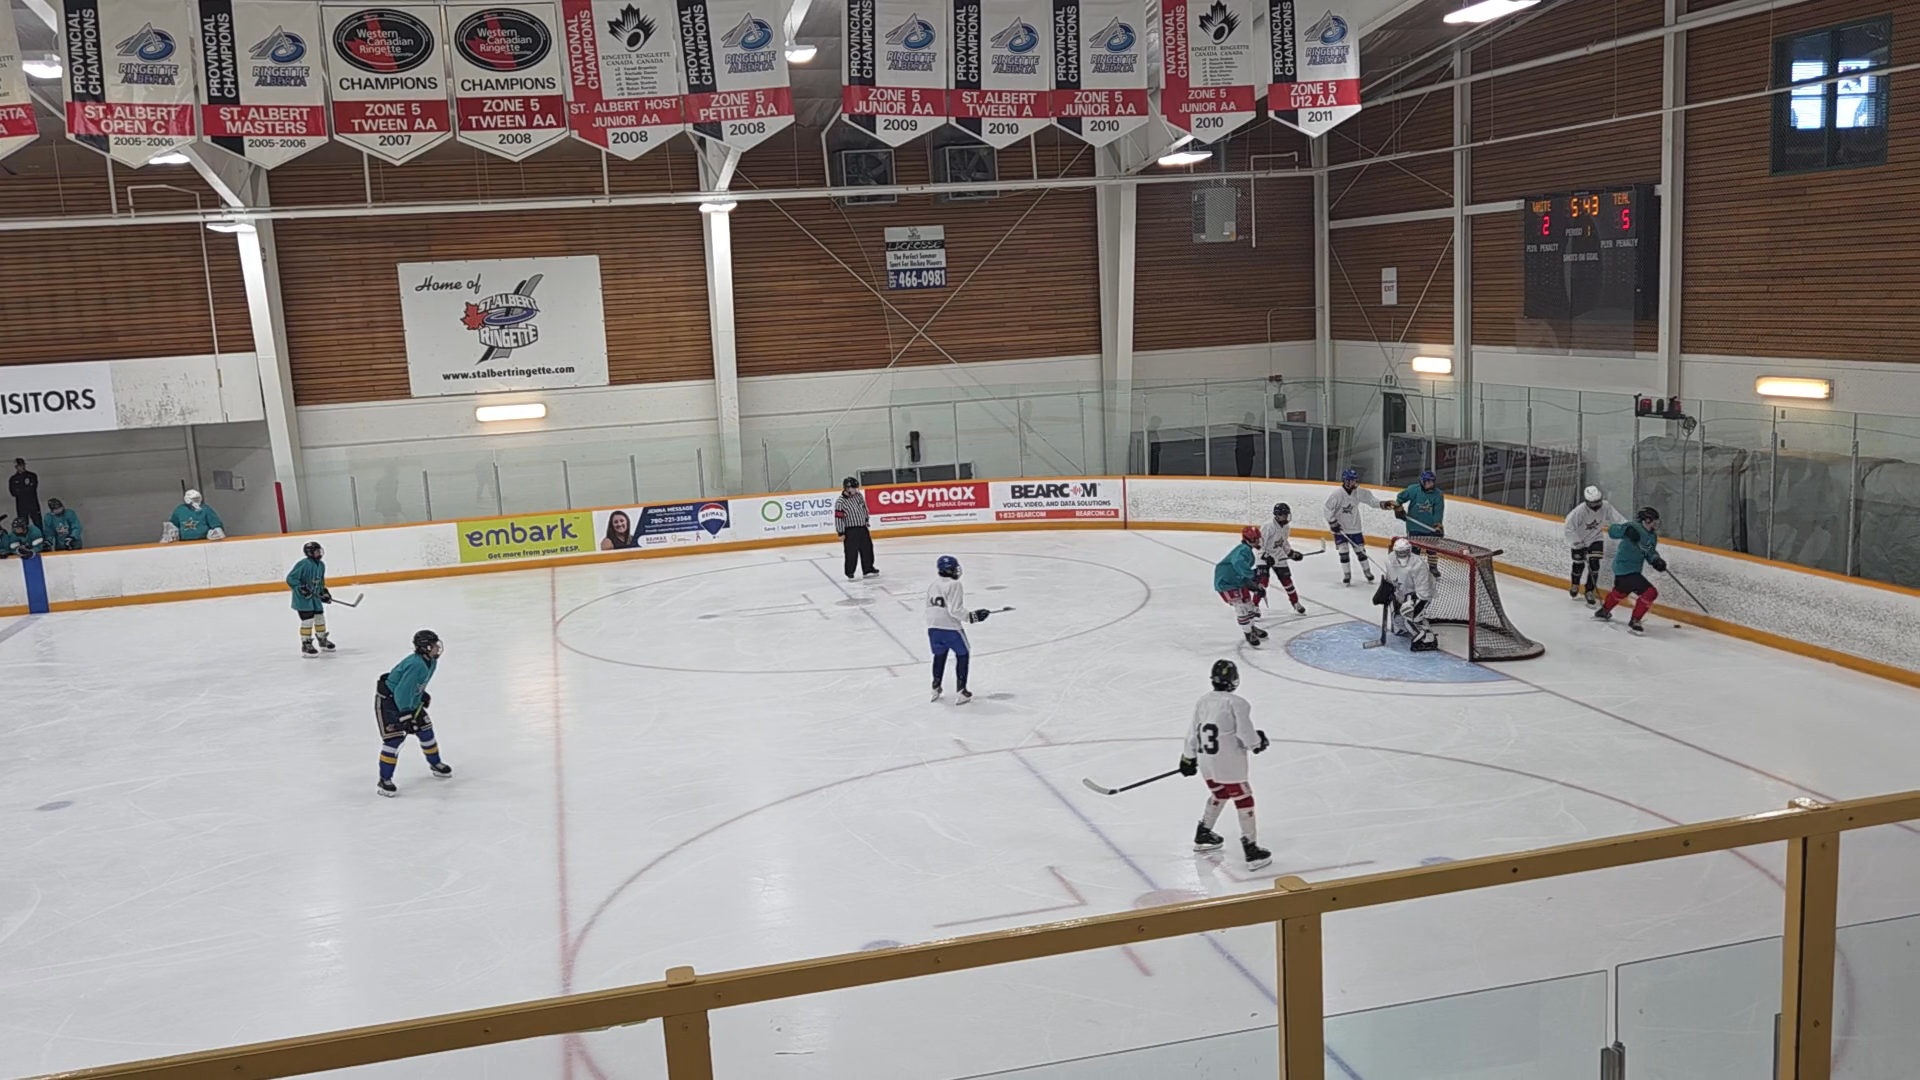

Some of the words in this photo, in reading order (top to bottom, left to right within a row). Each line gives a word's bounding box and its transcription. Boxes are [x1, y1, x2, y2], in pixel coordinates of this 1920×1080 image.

[356, 28, 398, 39] Western
[476, 27, 518, 37] Western
[850, 0, 861, 77] PROVINCIAL
[1271, 0, 1284, 75] PROVINCIAL
[1282, 0, 1295, 76] CHAMPIONS
[366, 37, 414, 46] Canadian
[486, 35, 533, 45] Canadian
[681, 6, 700, 85] PROVINCIAL
[693, 4, 713, 86] CHAMPIONS
[862, 0, 873, 79] CHAMPIONS
[956, 5, 967, 81] PROVINCIAL
[968, 4, 979, 82] CHAMPIONS
[1056, 5, 1068, 81] PROVINCIAL
[1068, 5, 1078, 82] CHAMPIONS
[1165, 9, 1176, 75] NATIONAL
[1176, 5, 1188, 79] CHAMPIONS
[67, 10, 86, 94] PROVINCIAL
[81, 8, 101, 95] CHAMPIONS
[218, 13, 236, 98] CHAMPIONS
[359, 44, 402, 56] Ringette
[479, 43, 521, 54] Ringette
[567, 16, 585, 86] NATIONAL
[580, 10, 599, 90] CHAMPIONS
[1305, 45, 1350, 58] RINGETTE
[202, 15, 222, 97] PROVINCIAL
[725, 51, 776, 64] RINGETTE
[886, 52, 937, 63] RINGETTE
[991, 54, 1040, 65] RINGETTE
[1090, 54, 1138, 65] RINGETTE
[1307, 55, 1348, 67] ALBERTA
[119, 63, 178, 76] RINGETTE
[252, 65, 310, 78] RINGETTE
[728, 61, 774, 74] ALBERTA
[888, 61, 933, 72] ALBERTA
[993, 63, 1037, 74] ALBERTA
[1092, 63, 1135, 74] ALBERTA
[121, 74, 175, 86] ALBERTA
[254, 76, 308, 88] ALBERTA
[339, 76, 438, 91] CHAMPIONS
[460, 77, 556, 92] CHAMPIONS
[868, 88, 906, 101] ZONE
[911, 90, 921, 102] 5
[1188, 89, 1217, 100] ZONE
[1219, 88, 1227, 99] 5
[1290, 83, 1325, 96] ZONE
[1328, 81, 1337, 93] 5
[710, 94, 749, 107] ZONE
[755, 91, 764, 103] 5
[962, 91, 983, 104] ST.
[984, 92, 1037, 105] ALBERT
[1074, 91, 1112, 103] ZONE
[1114, 91, 1123, 103] 5
[1290, 95, 1314, 108] U12
[1317, 94, 1337, 107] AA
[84, 104, 110, 119] ST.
[114, 103, 178, 120] ALBERT
[365, 103, 405, 116] ZONE
[411, 103, 421, 114] 5
[482, 99, 525, 112] ZONE
[529, 98, 540, 111] 5
[571, 103, 589, 114] ST.
[594, 101, 641, 113] ALBERT
[645, 98, 677, 110] HOST
[700, 107, 748, 121] PETITE
[754, 103, 778, 116] AA
[854, 101, 907, 114] JUNIOR
[911, 102, 934, 115] AA
[966, 104, 1017, 117] TWEEN
[1022, 105, 1033, 117] A
[1061, 103, 1112, 116] JUNIOR
[1114, 103, 1137, 115] AA
[1178, 101, 1217, 113] JUNIOR
[1220, 101, 1236, 112] AA
[219, 107, 246, 121] ST.
[248, 107, 311, 121] ALBERT
[468, 115, 527, 128] TWEEN
[532, 114, 557, 127] AA
[592, 115, 637, 128] JUNIOR
[641, 113, 661, 125] AA
[1307, 110, 1333, 123] 2011
[100, 120, 147, 134] OPEN
[152, 120, 166, 134] C
[225, 120, 307, 134] MASTERS
[351, 118, 408, 131] TWEEN
[413, 118, 437, 131] AA
[729, 122, 766, 136] 2008
[883, 119, 918, 131] 2009
[988, 122, 1019, 135] 2010
[1090, 119, 1120, 132] 2010
[1195, 116, 1224, 129] 2010
[113, 136, 175, 148] 2005-2006
[247, 138, 307, 149] 2005-2006
[378, 134, 412, 146] 2007
[498, 133, 532, 145] 2008
[611, 131, 649, 145] 2008
[1571, 195, 1599, 217] 5:43
[1543, 215, 1550, 235] 2
[1621, 209, 1630, 229] 5
[415, 275, 463, 293] Home
[466, 272, 483, 294] of
[898, 270, 946, 288] 466-0981
[479, 325, 539, 349] RINGETTE
[442, 365, 576, 381] www.stalbertringette.com
[878, 486, 976, 507] easymax
[1076, 499, 1111, 507] SOLUTIONS
[785, 498, 833, 511] servus
[785, 510, 809, 518] credit
[810, 509, 834, 517] union
[998, 511, 1047, 519] 1-833-BEARCOM
[465, 517, 579, 547] embark
[487, 552, 502, 560] Get
[502, 551, 522, 559] more
[522, 548, 540, 556] from
[541, 548, 559, 556] your
[559, 545, 581, 553] RESP.
